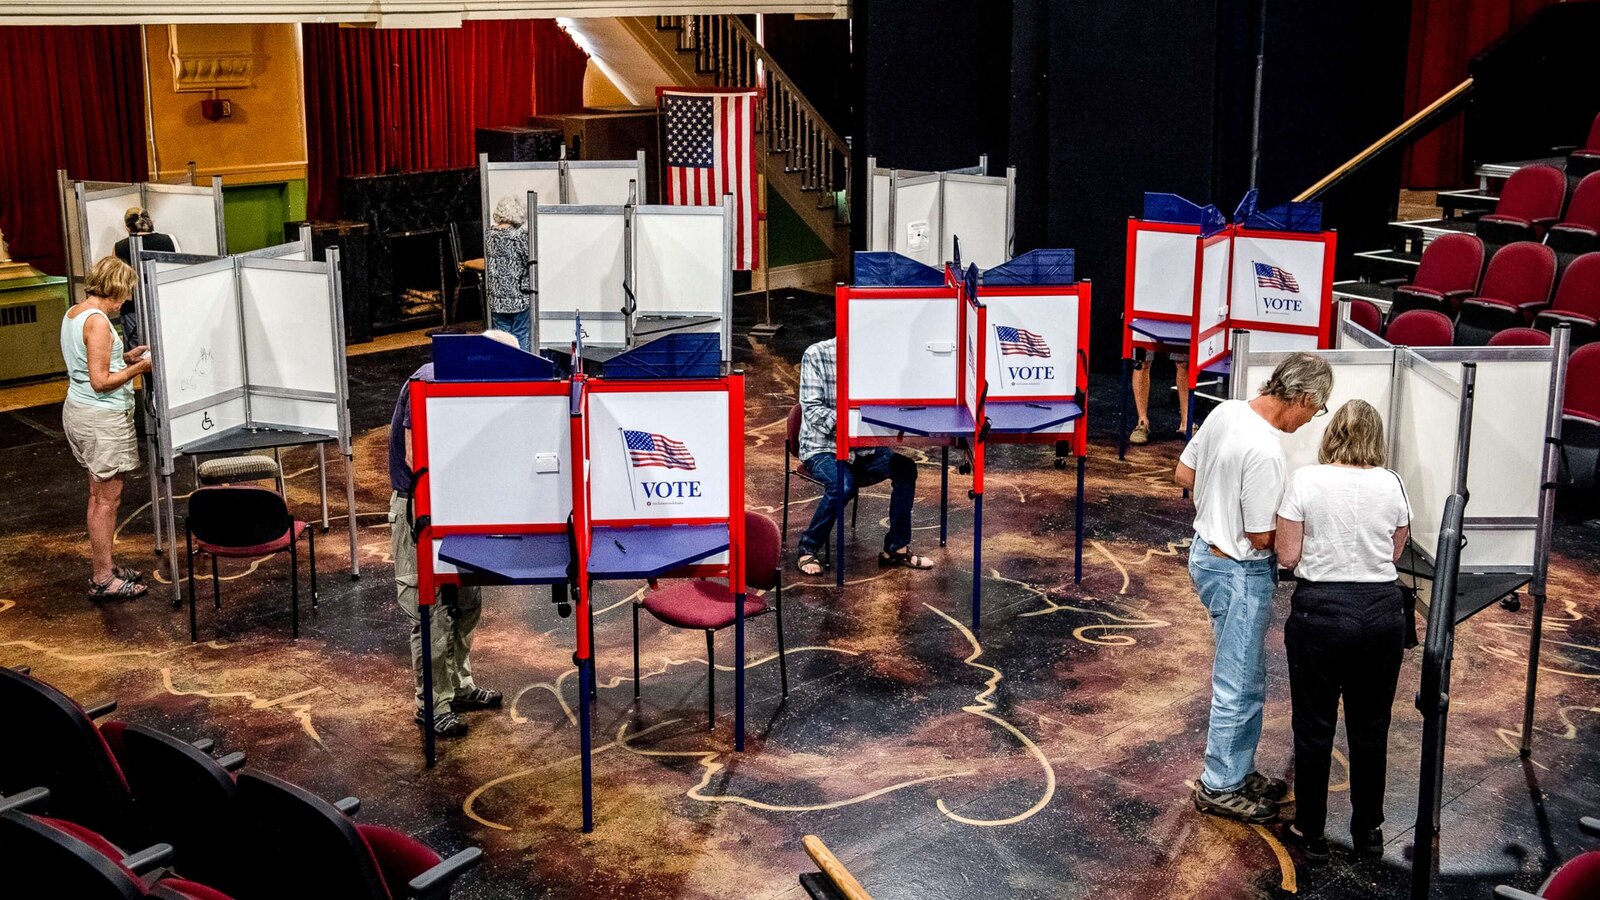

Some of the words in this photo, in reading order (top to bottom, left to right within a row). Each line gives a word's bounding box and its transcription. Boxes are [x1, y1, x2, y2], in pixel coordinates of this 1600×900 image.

[1263, 297, 1302, 311] VOTE
[1008, 366, 1055, 380] VOTE
[641, 481, 702, 498] VOTE
